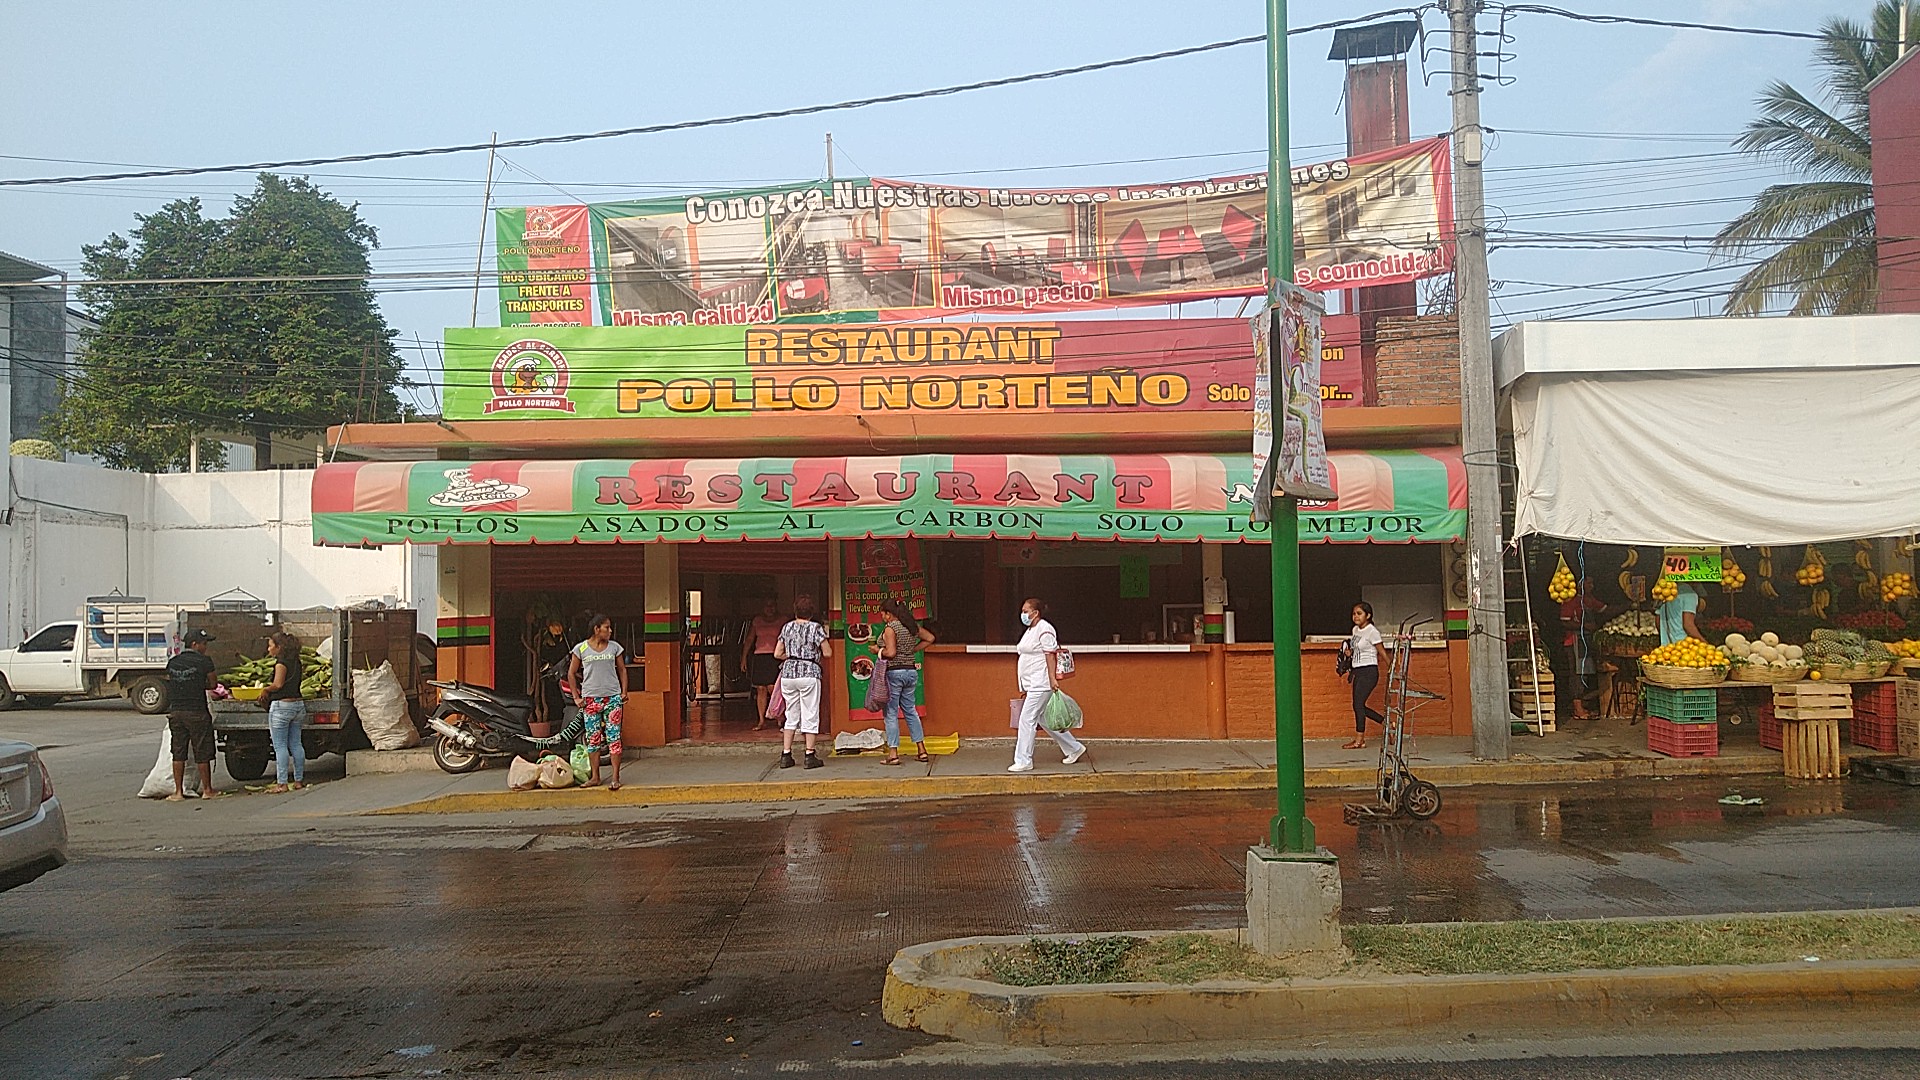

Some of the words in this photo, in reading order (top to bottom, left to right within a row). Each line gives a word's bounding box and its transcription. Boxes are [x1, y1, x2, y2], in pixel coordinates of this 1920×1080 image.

[686, 187, 825, 223] Conozca
[833, 181, 981, 209] Nuestras
[1117, 160, 1350, 201] Instalacines
[504, 247, 534, 255] POLLO
[536, 244, 581, 255] NORTEÑO
[1318, 246, 1443, 283] comodidad
[502, 271, 525, 283] NOS
[528, 269, 586, 282] UBICAMOS
[519, 285, 560, 298] FRENTE
[562, 284, 572, 297] A
[943, 286, 1016, 307] Mismo
[1024, 280, 1095, 308] precio
[506, 299, 584, 313] TRANSPORTES
[613, 310, 687, 326] Misma
[694, 300, 775, 326] calidad
[746, 328, 1061, 366] RESTAURANT
[618, 376, 838, 412] POLLO
[861, 366, 1188, 412] NORTEÑO
[1208, 383, 1251, 402] Solo
[499, 399, 522, 408] POLLO
[525, 398, 560, 408] NORTEÑO
[595, 472, 1153, 504] RESTAURANT
[386, 516, 520, 534] POLLOS
[577, 514, 729, 533] ASADOS
[778, 513, 826, 530] AL
[896, 509, 1044, 529] CARBON
[1097, 514, 1184, 532] SOLO
[1306, 515, 1426, 533] MEJOR
[1666, 557, 1687, 572] 40
[1688, 561, 1700, 572] LA
[846, 576, 869, 584] JUEVES
[871, 576, 881, 584] DE
[845, 591, 854, 600] En
[862, 592, 888, 601] compra
[890, 589, 899, 599] de
[900, 590, 910, 598] un
[911, 586, 926, 597] pollo
[908, 599, 925, 610] pollo
